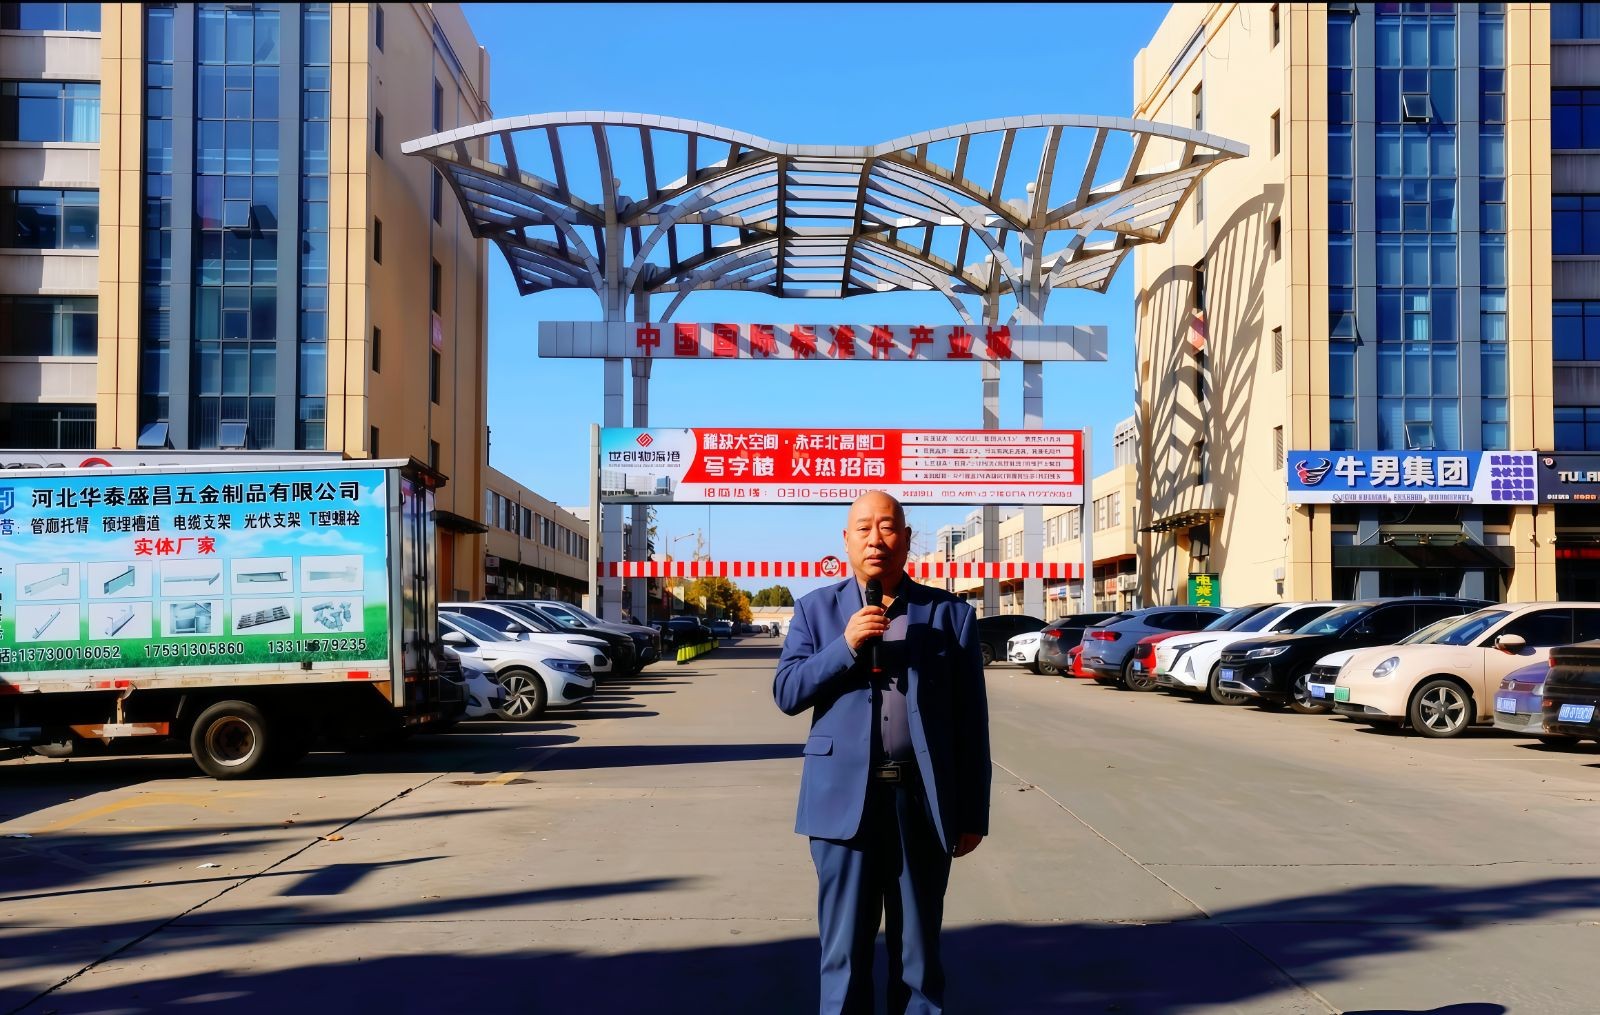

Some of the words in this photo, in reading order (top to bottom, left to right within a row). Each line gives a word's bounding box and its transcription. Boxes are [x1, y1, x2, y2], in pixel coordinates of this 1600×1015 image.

[636, 322, 1013, 360] 中国国际标准件产业城
[791, 457, 885, 478] 火热招商
[1334, 455, 1469, 487] 牛男集团
[1558, 471, 1600, 482] TULA
[31, 480, 360, 509] 河北华泰盛昌五金制品有限公司
[31, 516, 89, 535] 管廊托臂
[102, 514, 161, 533] 预埋槽道
[173, 513, 231, 531] 电缆支架
[244, 511, 301, 529] 光伏支架
[309, 509, 361, 527] T型螺栓
[134, 536, 216, 556] 实体厂家
[144, 642, 245, 657] 17531305860
